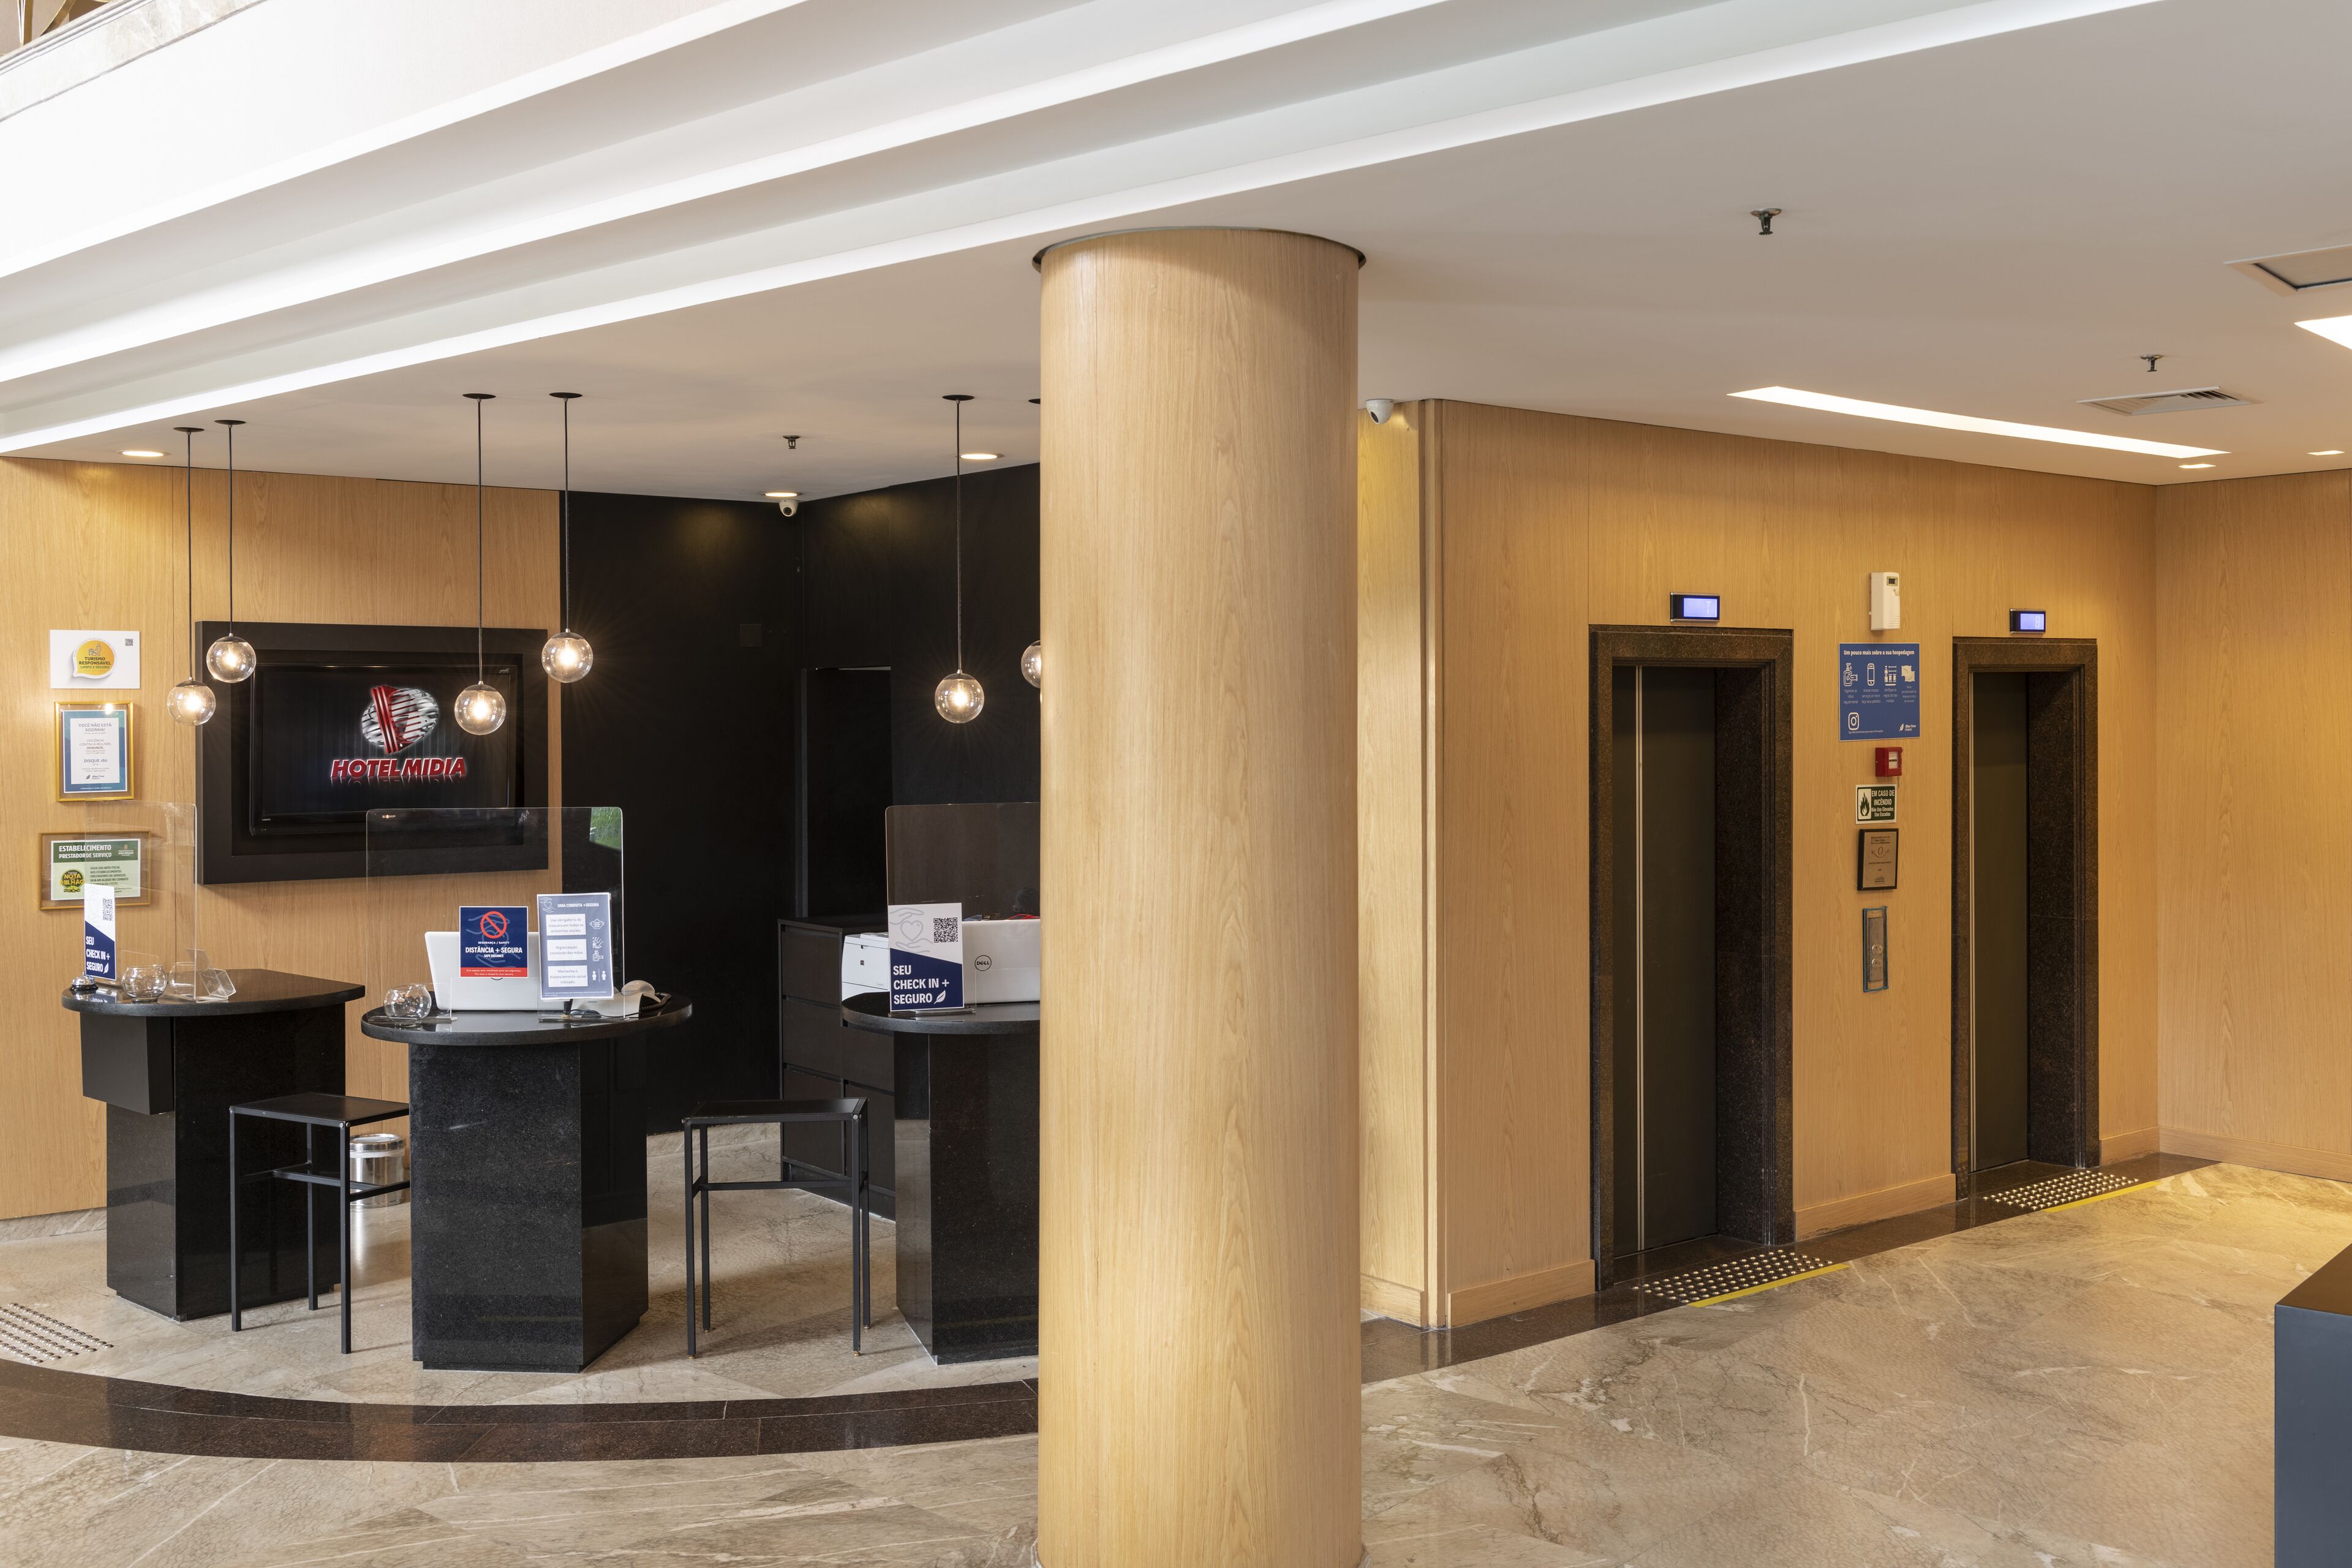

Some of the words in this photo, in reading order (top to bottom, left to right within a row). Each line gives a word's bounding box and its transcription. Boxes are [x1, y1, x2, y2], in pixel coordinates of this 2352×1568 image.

[330, 759, 400, 777] HOTEL
[401, 757, 467, 776] MIDIA
[86, 949, 100, 959] CHECK
[100, 951, 105, 960] IN
[86, 962, 103, 972] SEGURO
[893, 965, 911, 975] SEU
[894, 979, 926, 990] CHECK
[929, 978, 939, 988] IN
[894, 993, 932, 1005] SEGURO
